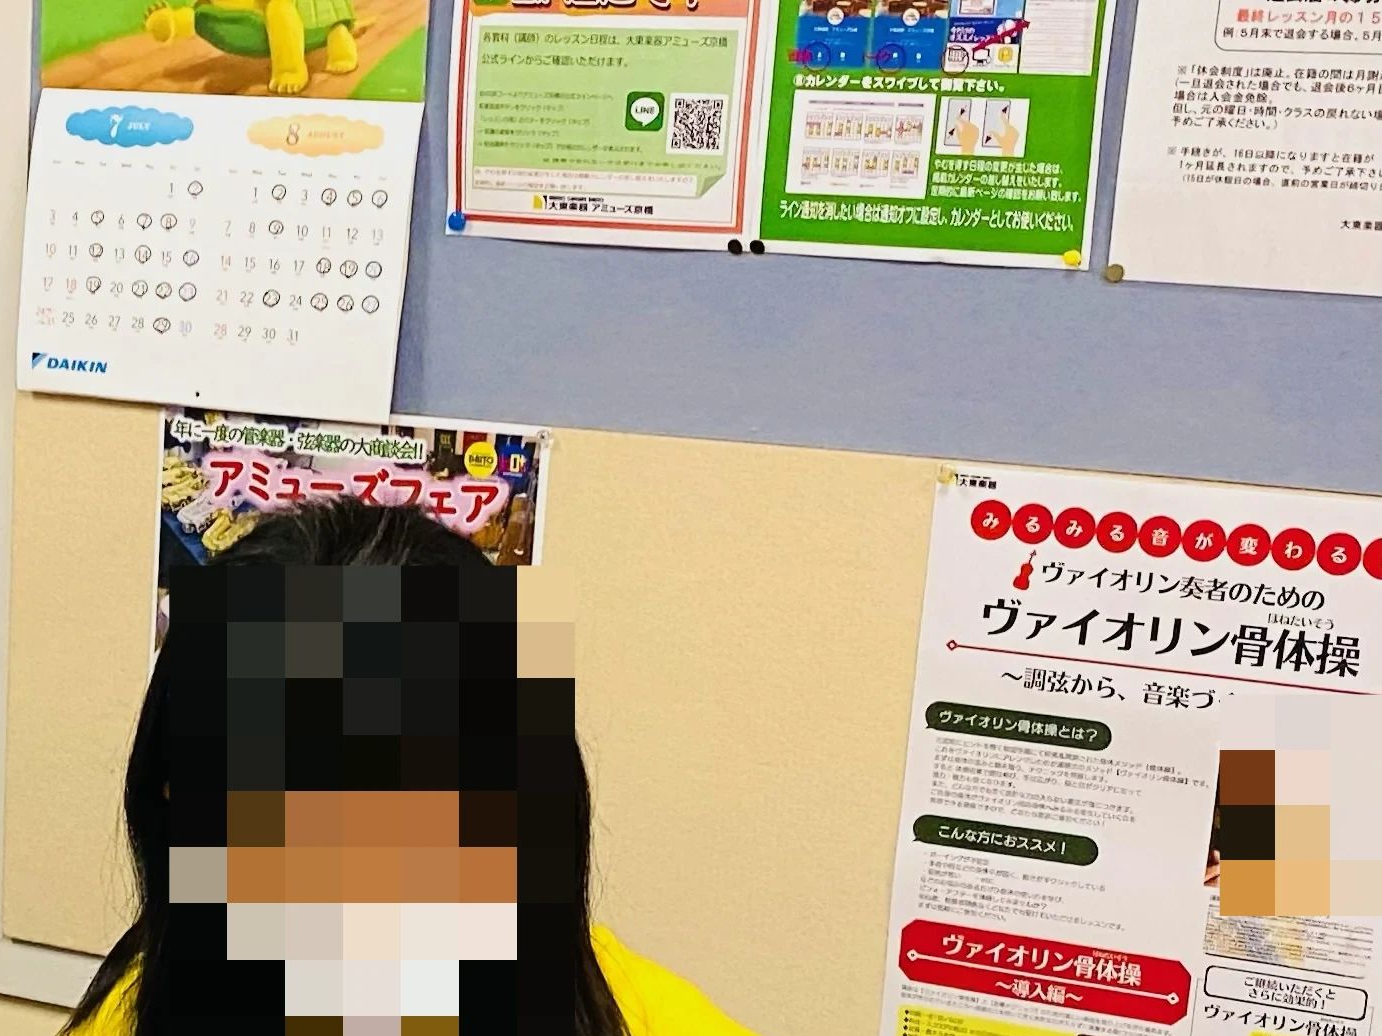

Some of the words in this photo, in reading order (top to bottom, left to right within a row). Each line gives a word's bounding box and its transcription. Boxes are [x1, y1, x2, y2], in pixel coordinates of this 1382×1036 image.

[285, 123, 300, 145] 8
[635, 106, 655, 115] LINE
[47, 356, 108, 374] DAIKIN
[210, 459, 499, 523] アミューズフェア
[983, 512, 1349, 564] みるみる音が変わる
[1042, 562, 1326, 611] ヴァイオリン奏者のための
[983, 598, 1361, 677] ヴァイオリン骨体操
[942, 934, 1142, 987] ヴァイオリン骨体操
